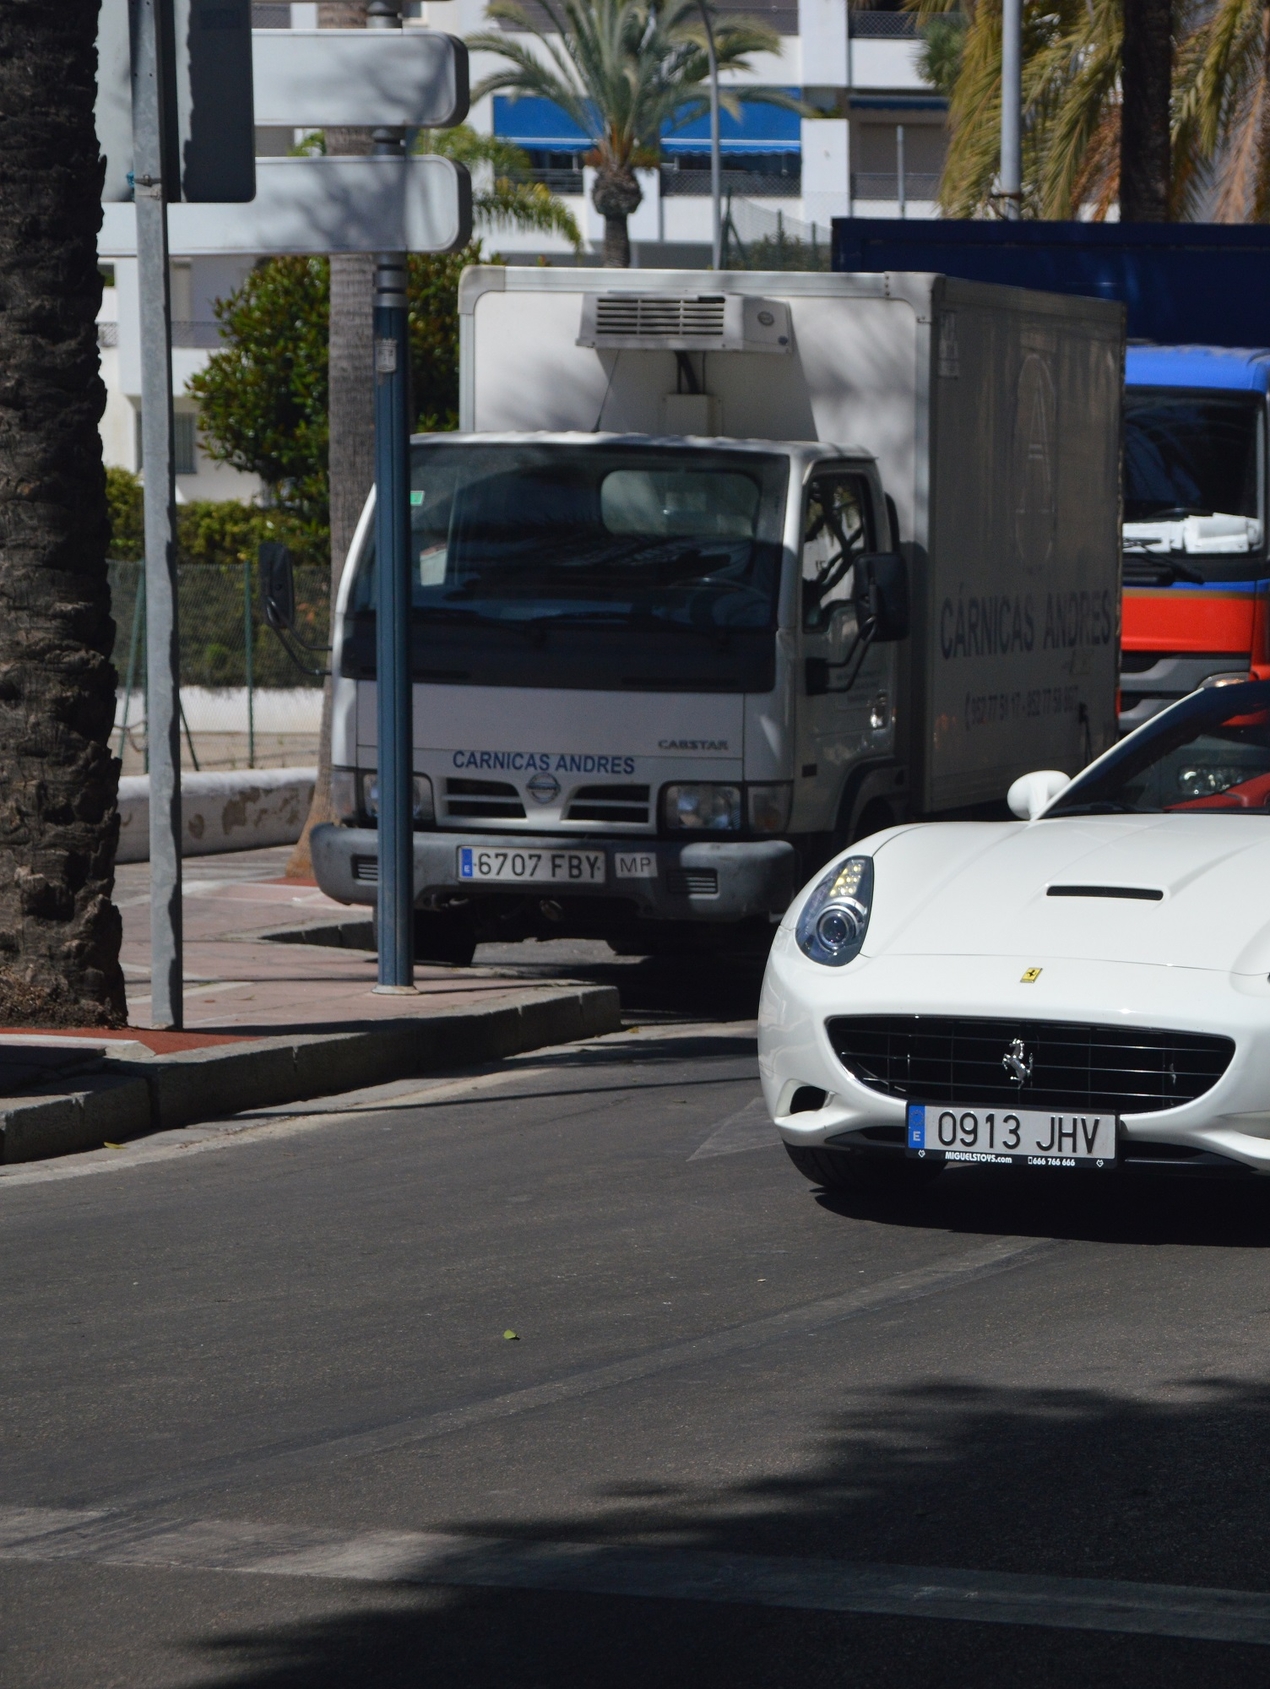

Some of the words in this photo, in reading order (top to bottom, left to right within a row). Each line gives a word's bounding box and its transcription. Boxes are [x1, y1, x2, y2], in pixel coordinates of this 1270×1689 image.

[1043, 589, 1111, 649] ANDRES
[452, 750, 550, 771] CARNICAS
[555, 755, 635, 774] ANDRES
[477, 853, 541, 876] 6707
[551, 854, 599, 879] FBY
[620, 857, 651, 873] MP
[913, 1131, 921, 1141] E
[938, 1111, 1021, 1150] 0913
[1036, 1116, 1100, 1154] JHV
[945, 1151, 1012, 1164] MIGUELSTOYS.com
[1032, 1157, 1046, 1166] 666
[1047, 1158, 1061, 1166] 766
[1062, 1158, 1075, 1167] 666
